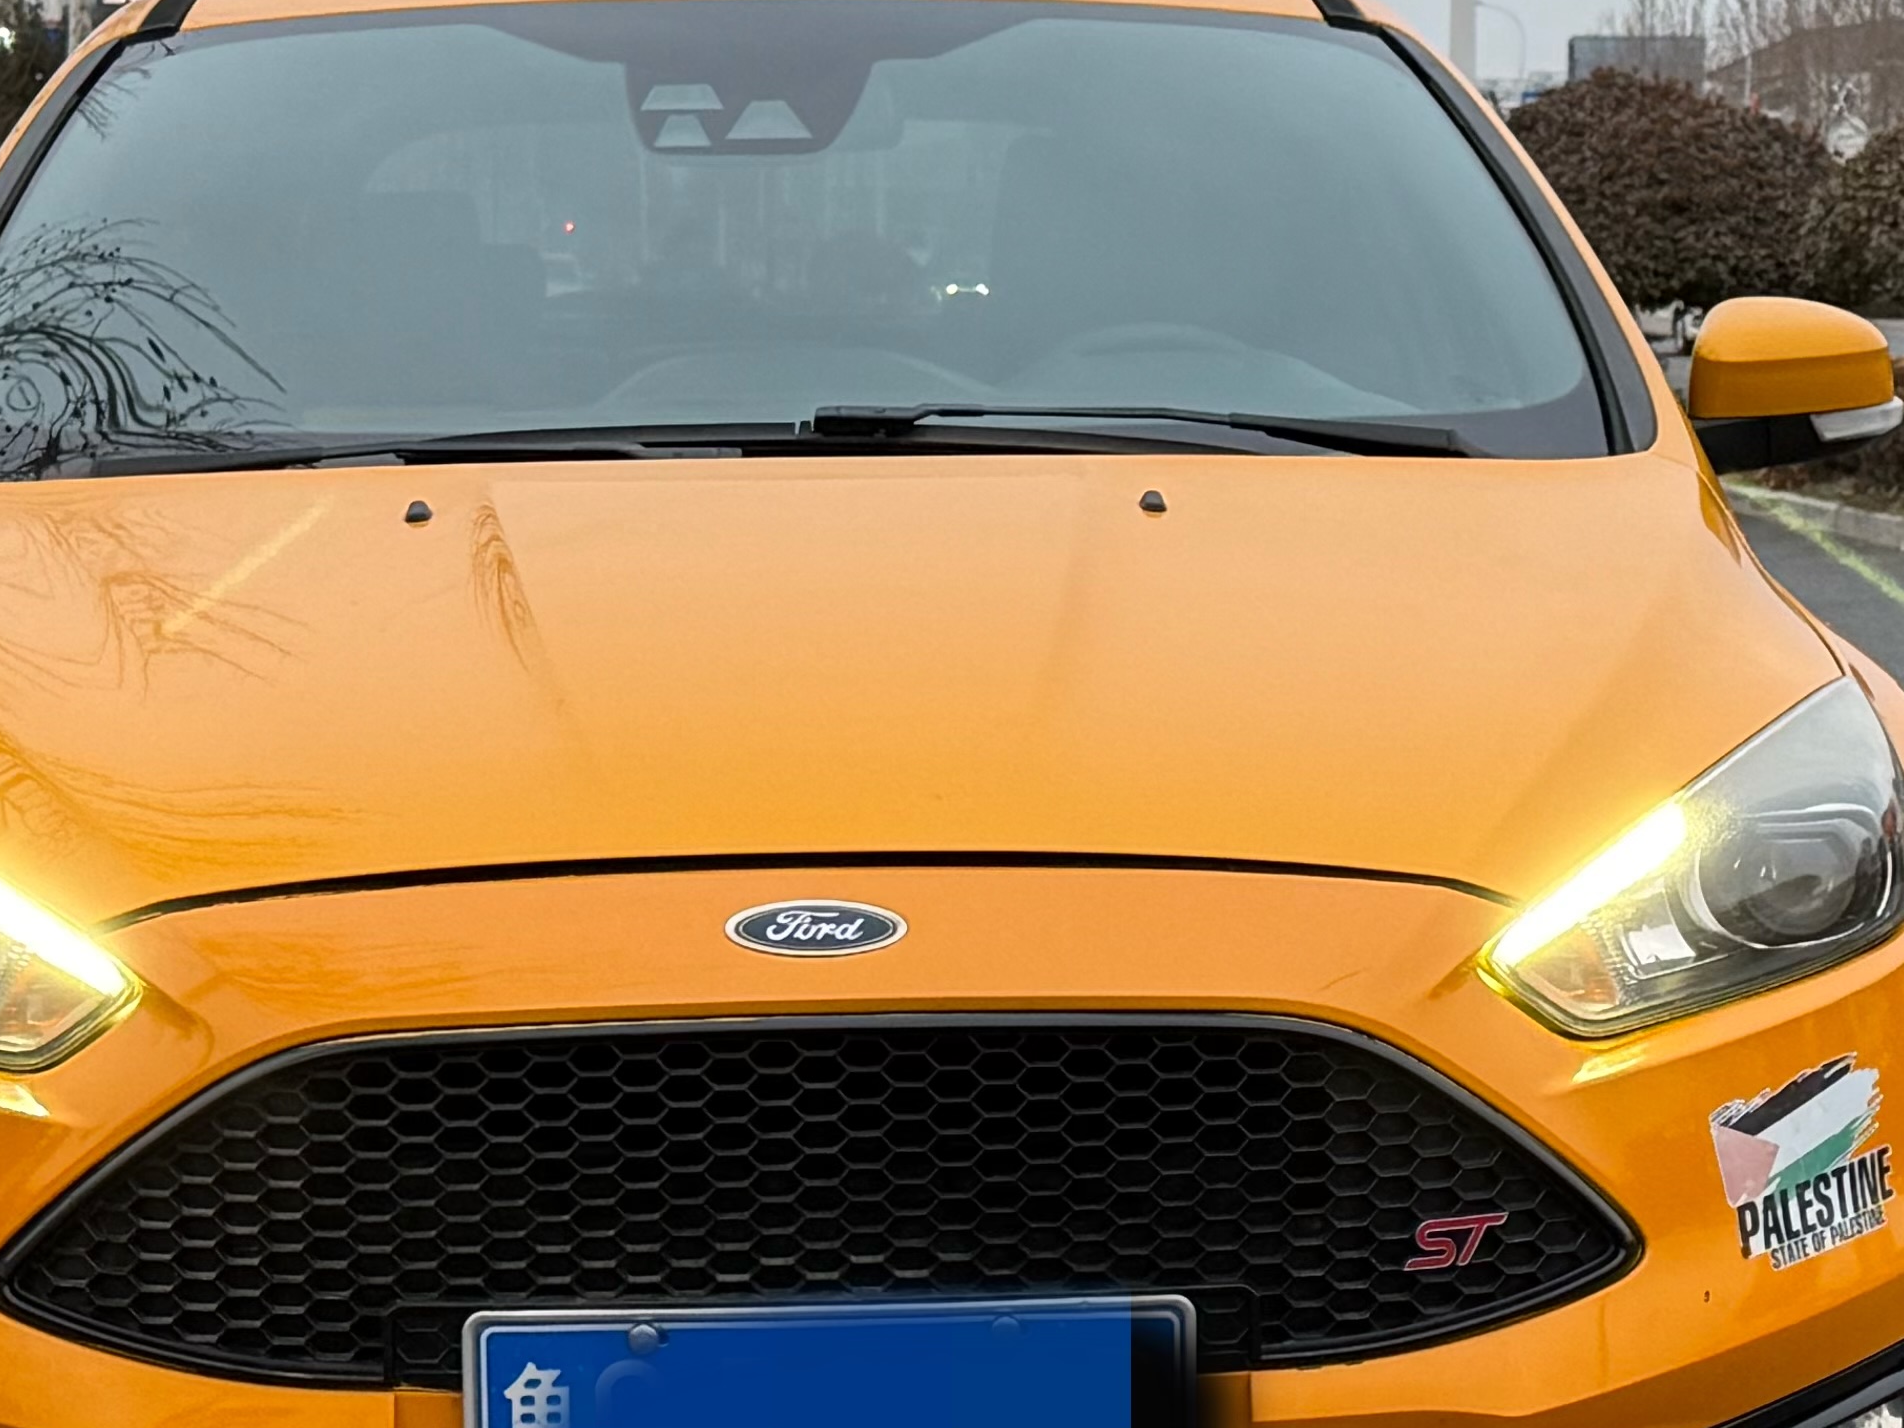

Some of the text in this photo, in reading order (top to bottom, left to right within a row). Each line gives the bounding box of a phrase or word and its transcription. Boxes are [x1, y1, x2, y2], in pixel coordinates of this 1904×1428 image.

[765, 910, 865, 941] Ford
[1737, 1146, 1894, 1260] PALESTINE
[1403, 1212, 1509, 1271] ST
[1770, 1204, 1886, 1270] STATE OF PALESTINE
